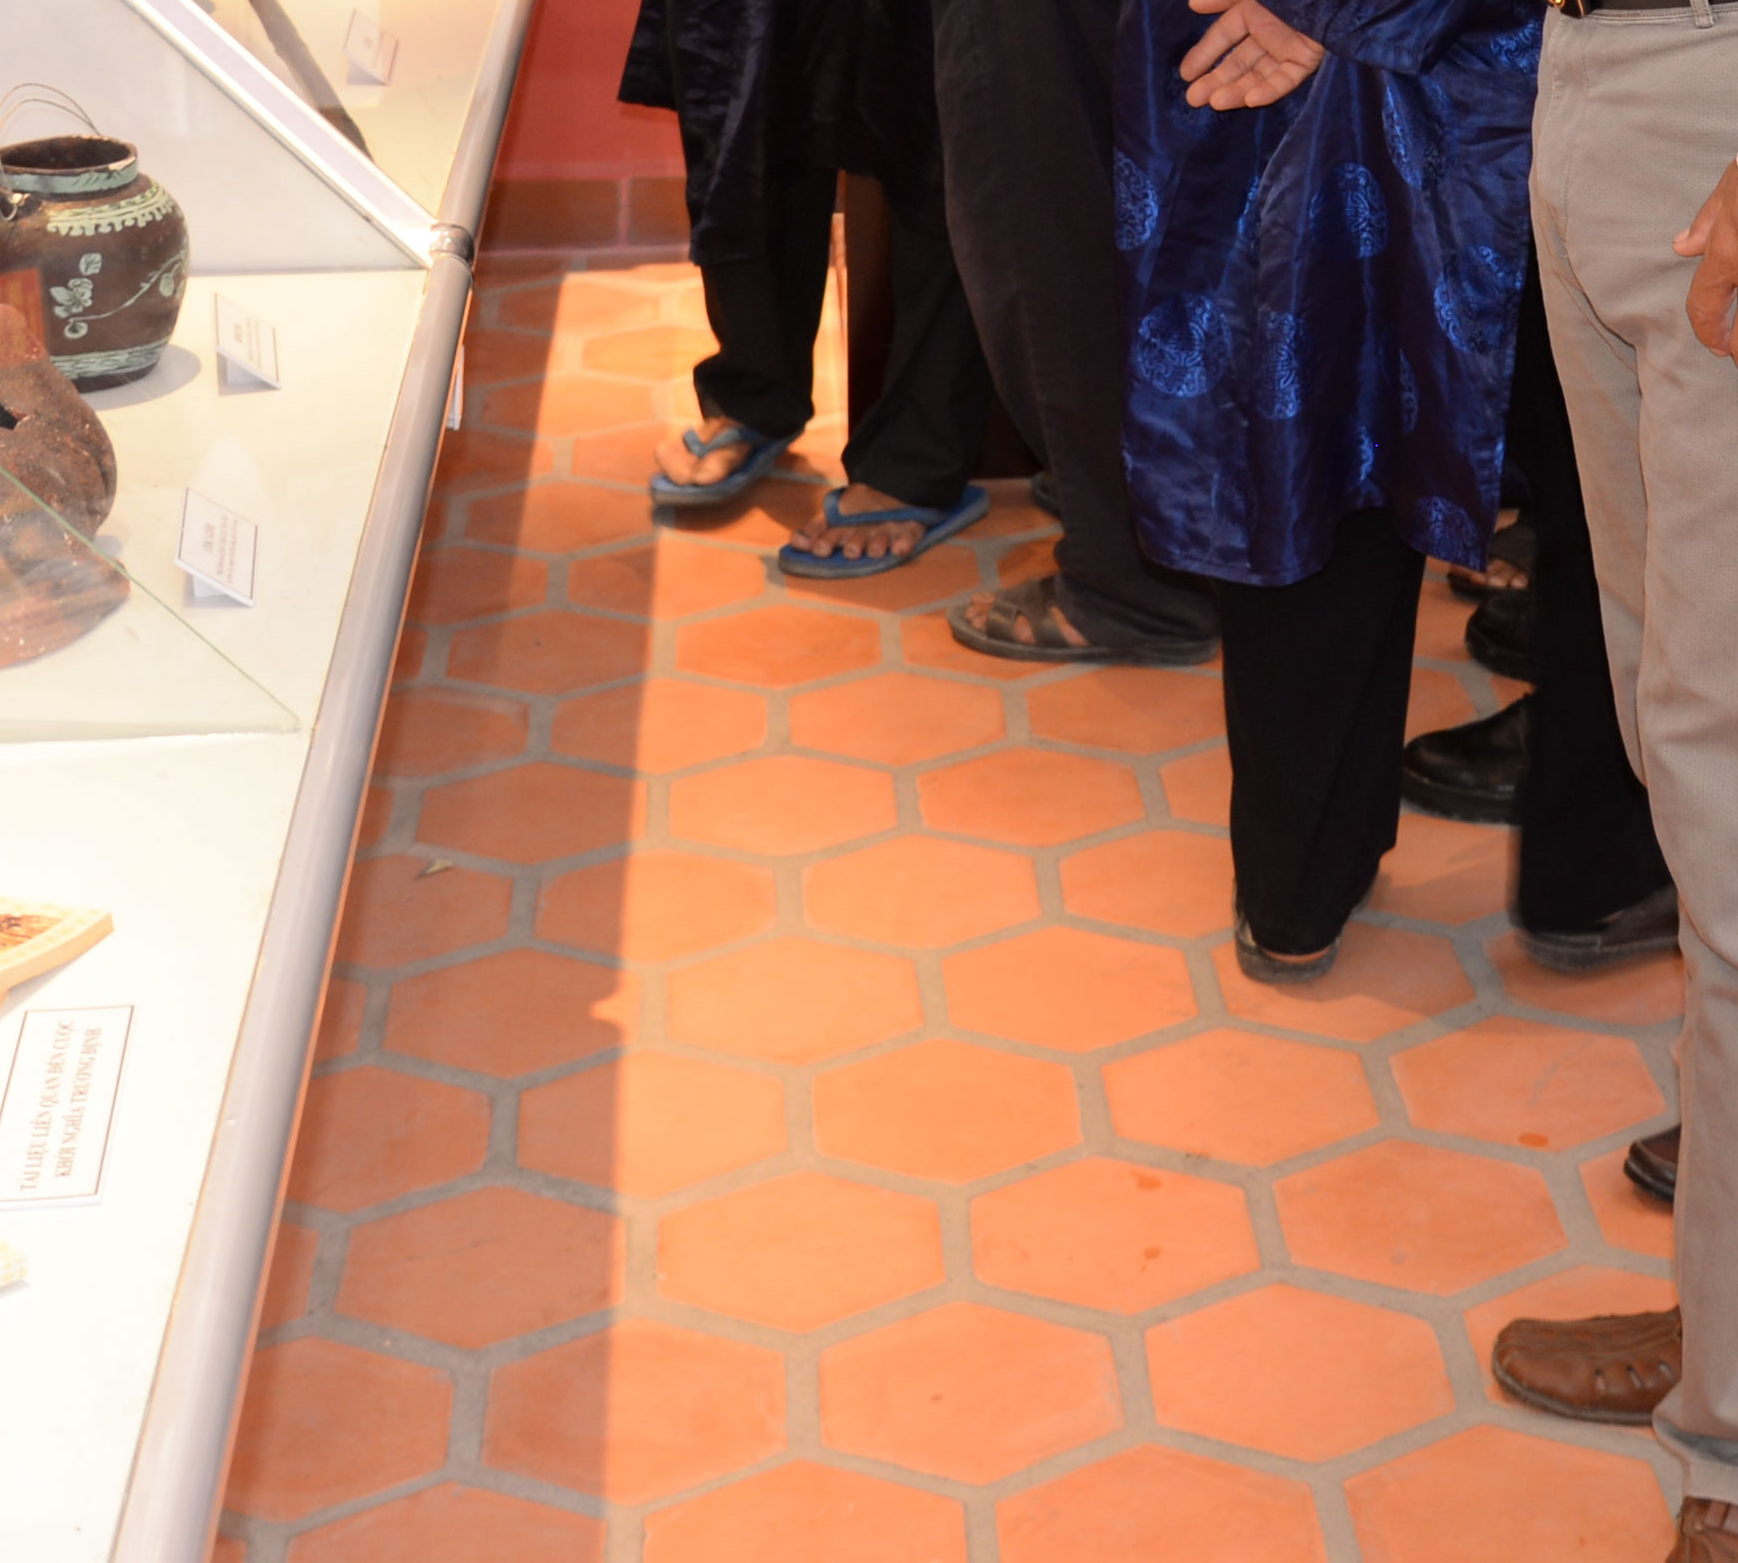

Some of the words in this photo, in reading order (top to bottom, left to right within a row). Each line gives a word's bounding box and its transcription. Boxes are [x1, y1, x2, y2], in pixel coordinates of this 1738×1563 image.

[80, 1027, 102, 1055] ĐỊNH
[24, 1140, 50, 1169] LIỆU
[39, 1076, 61, 1108] QUAN
[53, 1020, 76, 1050] CUỘC
